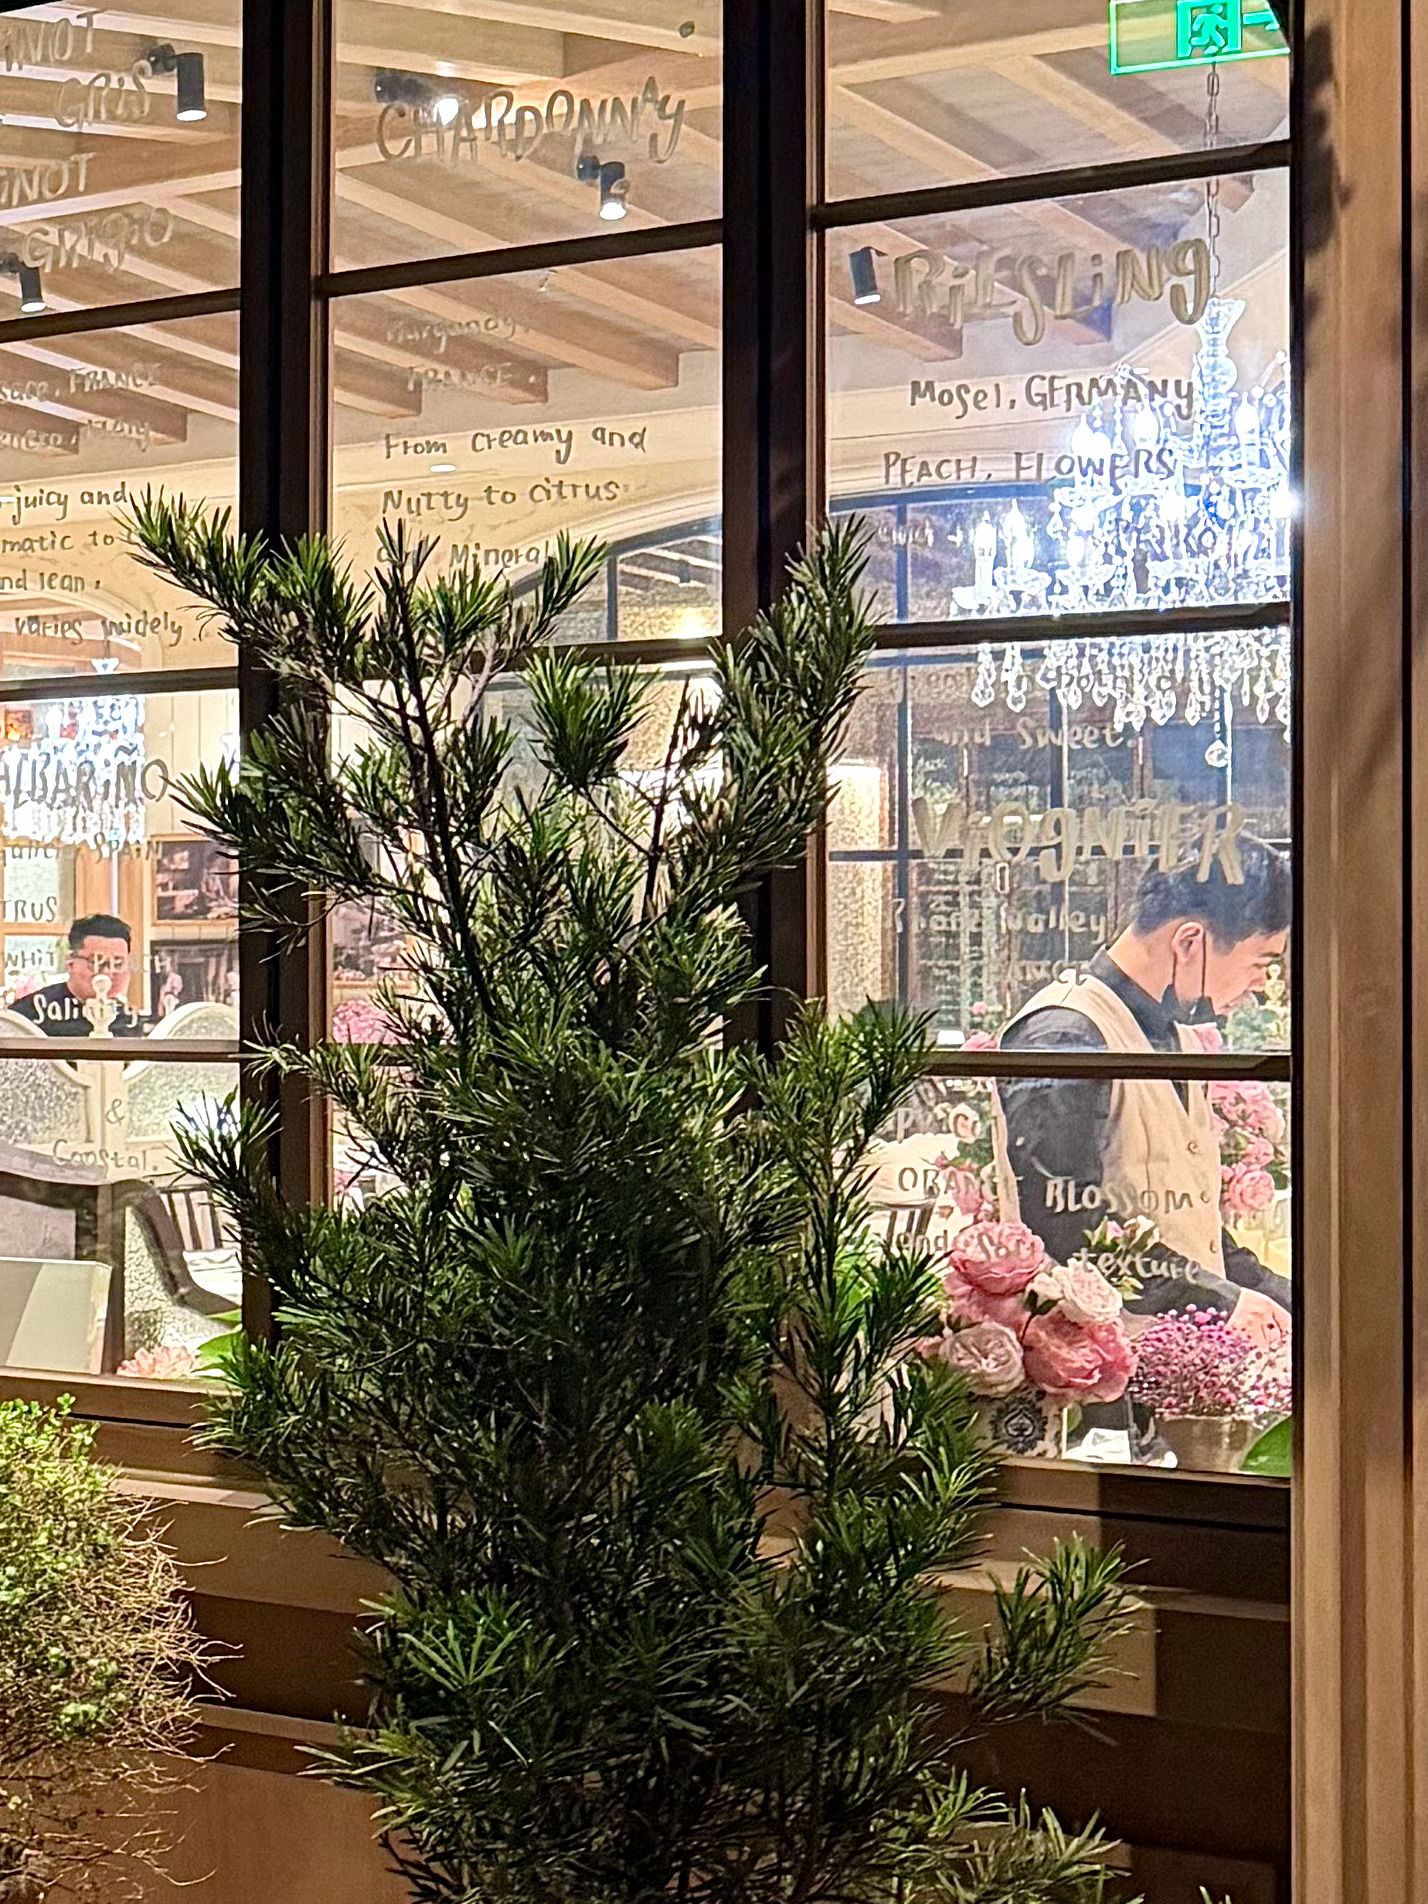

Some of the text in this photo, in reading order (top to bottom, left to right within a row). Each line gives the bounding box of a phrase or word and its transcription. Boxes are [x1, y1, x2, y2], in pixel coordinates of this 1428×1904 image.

[375, 75, 687, 165] CHARDONNAY
[1024, 373, 1196, 421] GERMANY
[385, 432, 448, 460] From
[591, 426, 648, 453] and
[11, 485, 69, 526] juicy
[80, 480, 129, 506] and
[381, 488, 469, 522] Nutty
[483, 484, 516, 505] to
[87, 530, 116, 548] to
[105, 1098, 126, 1127] &
[1044, 1176, 1193, 1219] BLOSSOM
[1072, 1246, 1202, 1284] texture
